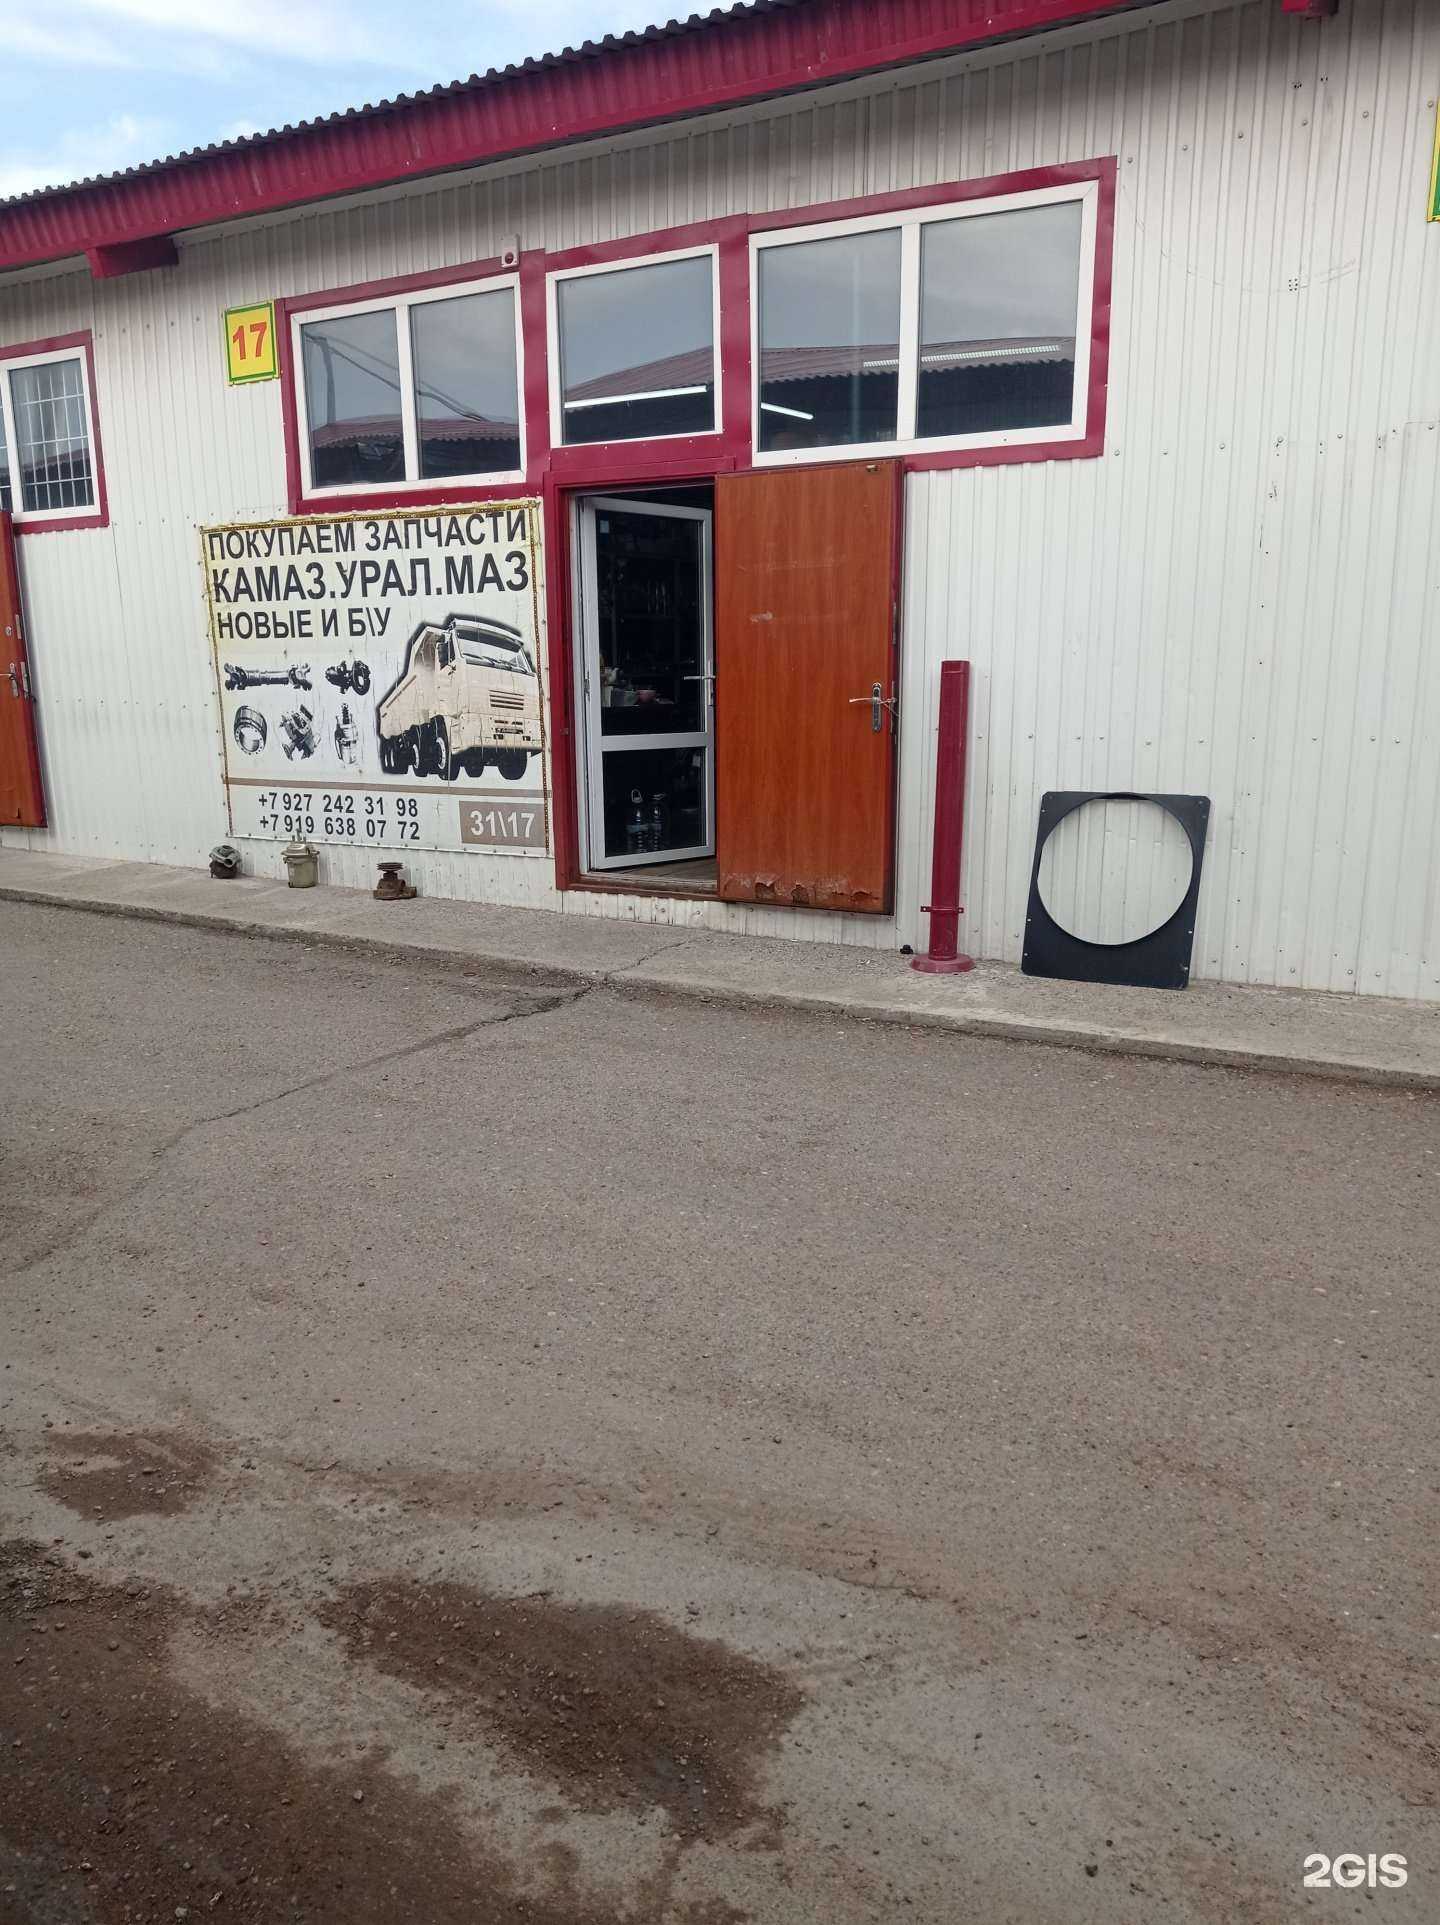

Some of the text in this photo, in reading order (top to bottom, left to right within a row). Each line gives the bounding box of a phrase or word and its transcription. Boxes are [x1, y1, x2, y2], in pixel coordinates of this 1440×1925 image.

[232, 321, 268, 361] 17
[208, 509, 527, 561] ПОКУПАЕМ ЗАПЧАСТИ
[217, 606, 391, 640] НОВЫЕ И Б\У
[282, 792, 313, 812] 927
[323, 794, 355, 814] 242
[364, 796, 385, 816] 31
[396, 798, 418, 818] 98
[324, 816, 356, 837] 638
[366, 818, 387, 839] 07
[397, 820, 420, 841] 72
[469, 809, 536, 839] 31\17
